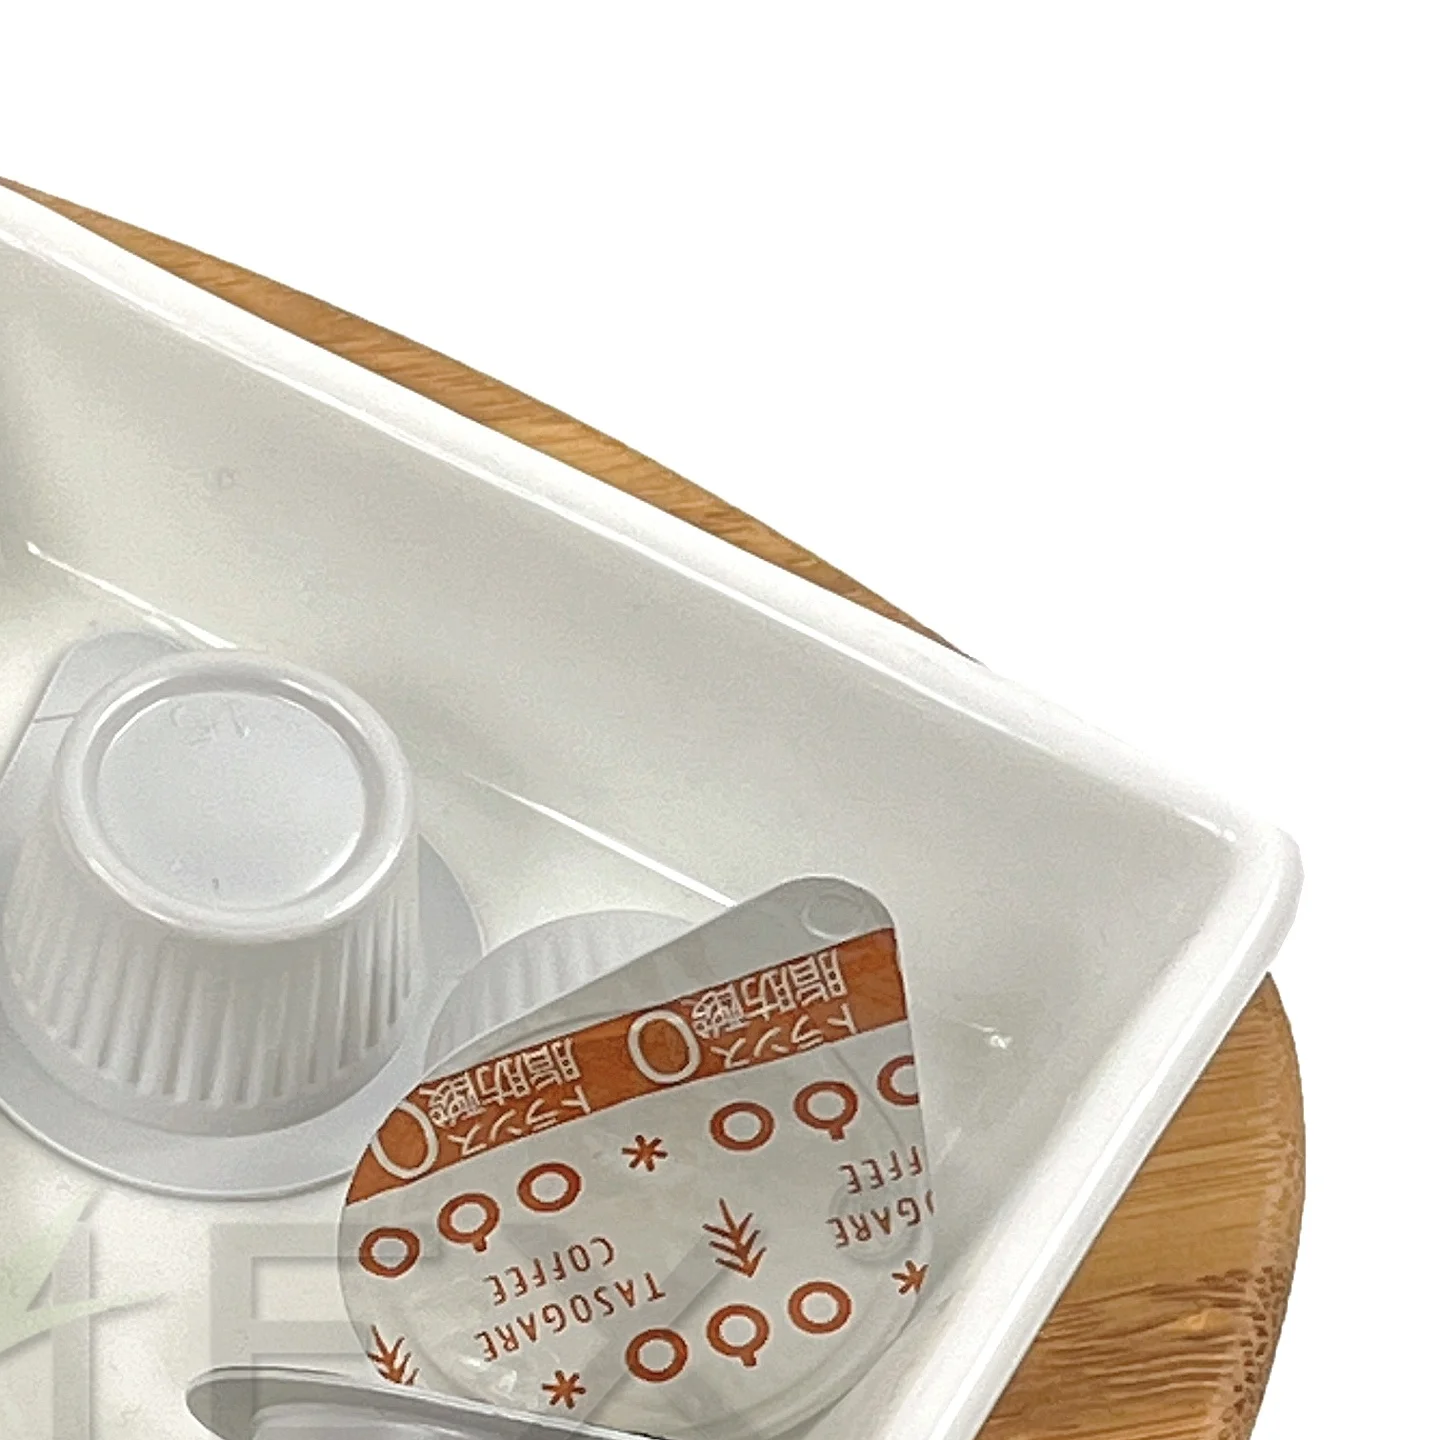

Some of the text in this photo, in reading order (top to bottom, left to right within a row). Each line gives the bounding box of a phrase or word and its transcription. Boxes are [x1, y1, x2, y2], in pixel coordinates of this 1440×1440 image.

[680, 948, 848, 1040] 脂肪酸
[709, 1002, 858, 1070] トランス
[447, 1084, 592, 1156] トランス
[483, 1235, 616, 1306] COFFEE
[473, 1271, 667, 1362] TASOGARE
